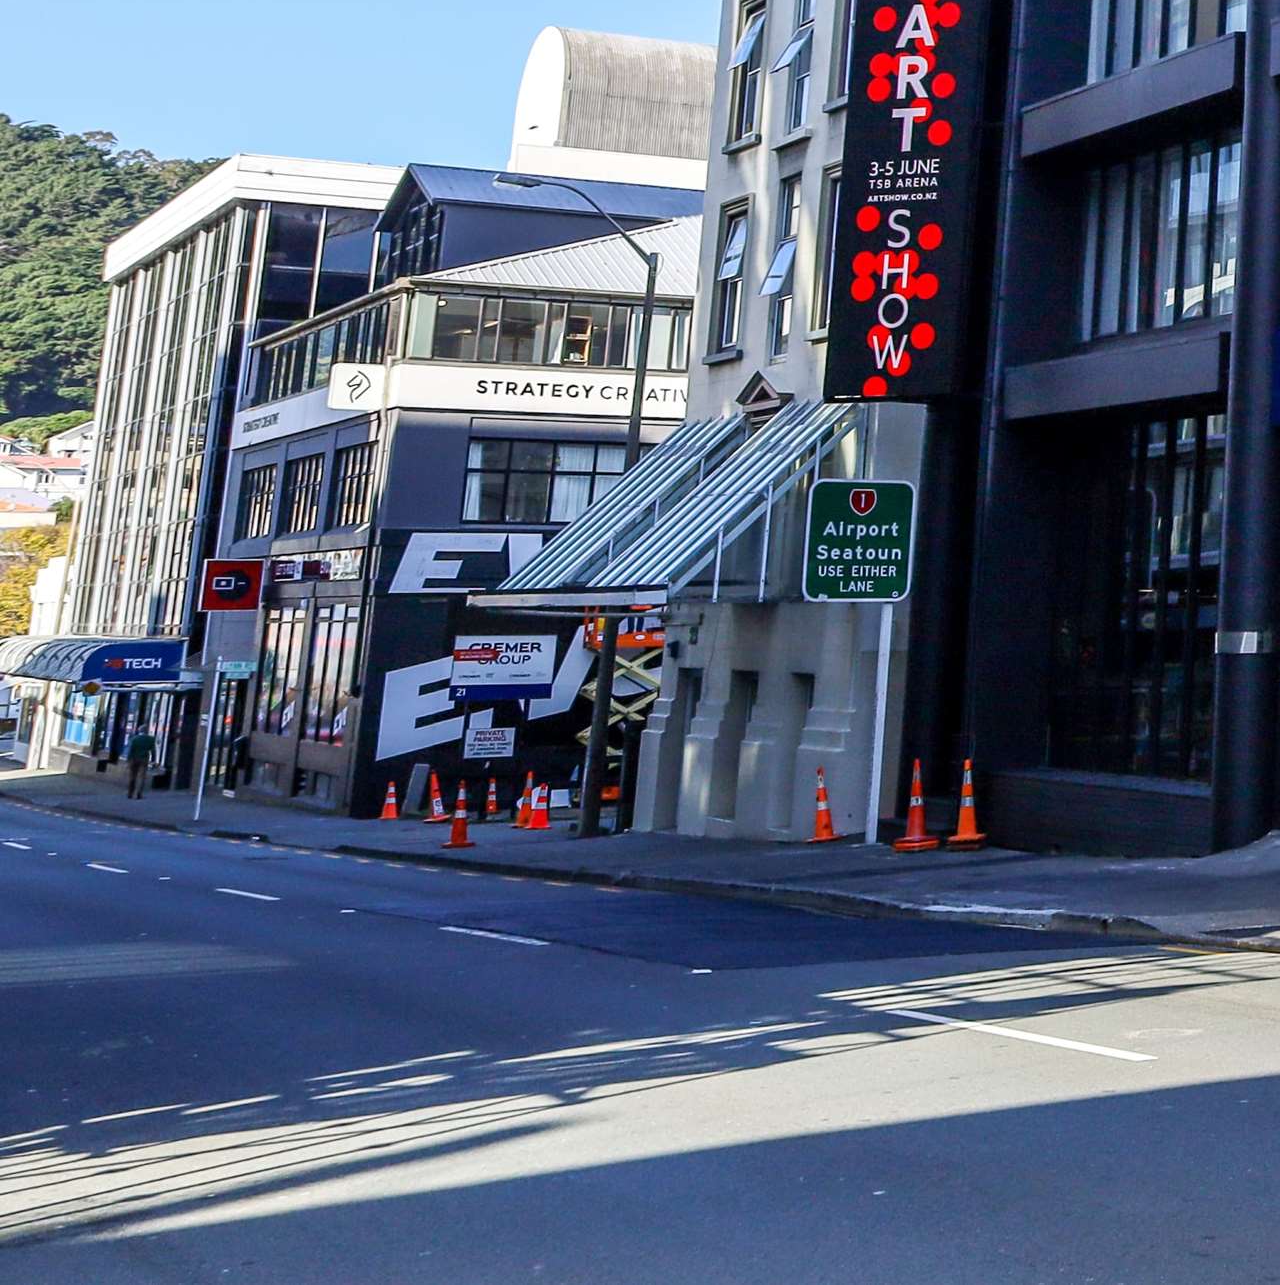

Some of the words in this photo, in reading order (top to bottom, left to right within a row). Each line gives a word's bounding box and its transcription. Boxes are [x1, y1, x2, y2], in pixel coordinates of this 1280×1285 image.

[891, 3, 936, 153] ART
[868, 161, 895, 177] 3-5
[897, 158, 941, 175] JUNE
[868, 179, 892, 190] TSB
[896, 176, 939, 189] ARENA
[867, 192, 938, 203] ARTSHOW.CO.NZ
[871, 208, 912, 370] SHOW
[476, 379, 594, 399] STRATEGY
[860, 493, 866, 508] 1
[823, 521, 900, 540] Airport
[816, 545, 902, 560] Seatoun
[818, 565, 844, 577] USE
[851, 565, 897, 577] EITHER
[839, 581, 875, 593] LANE
